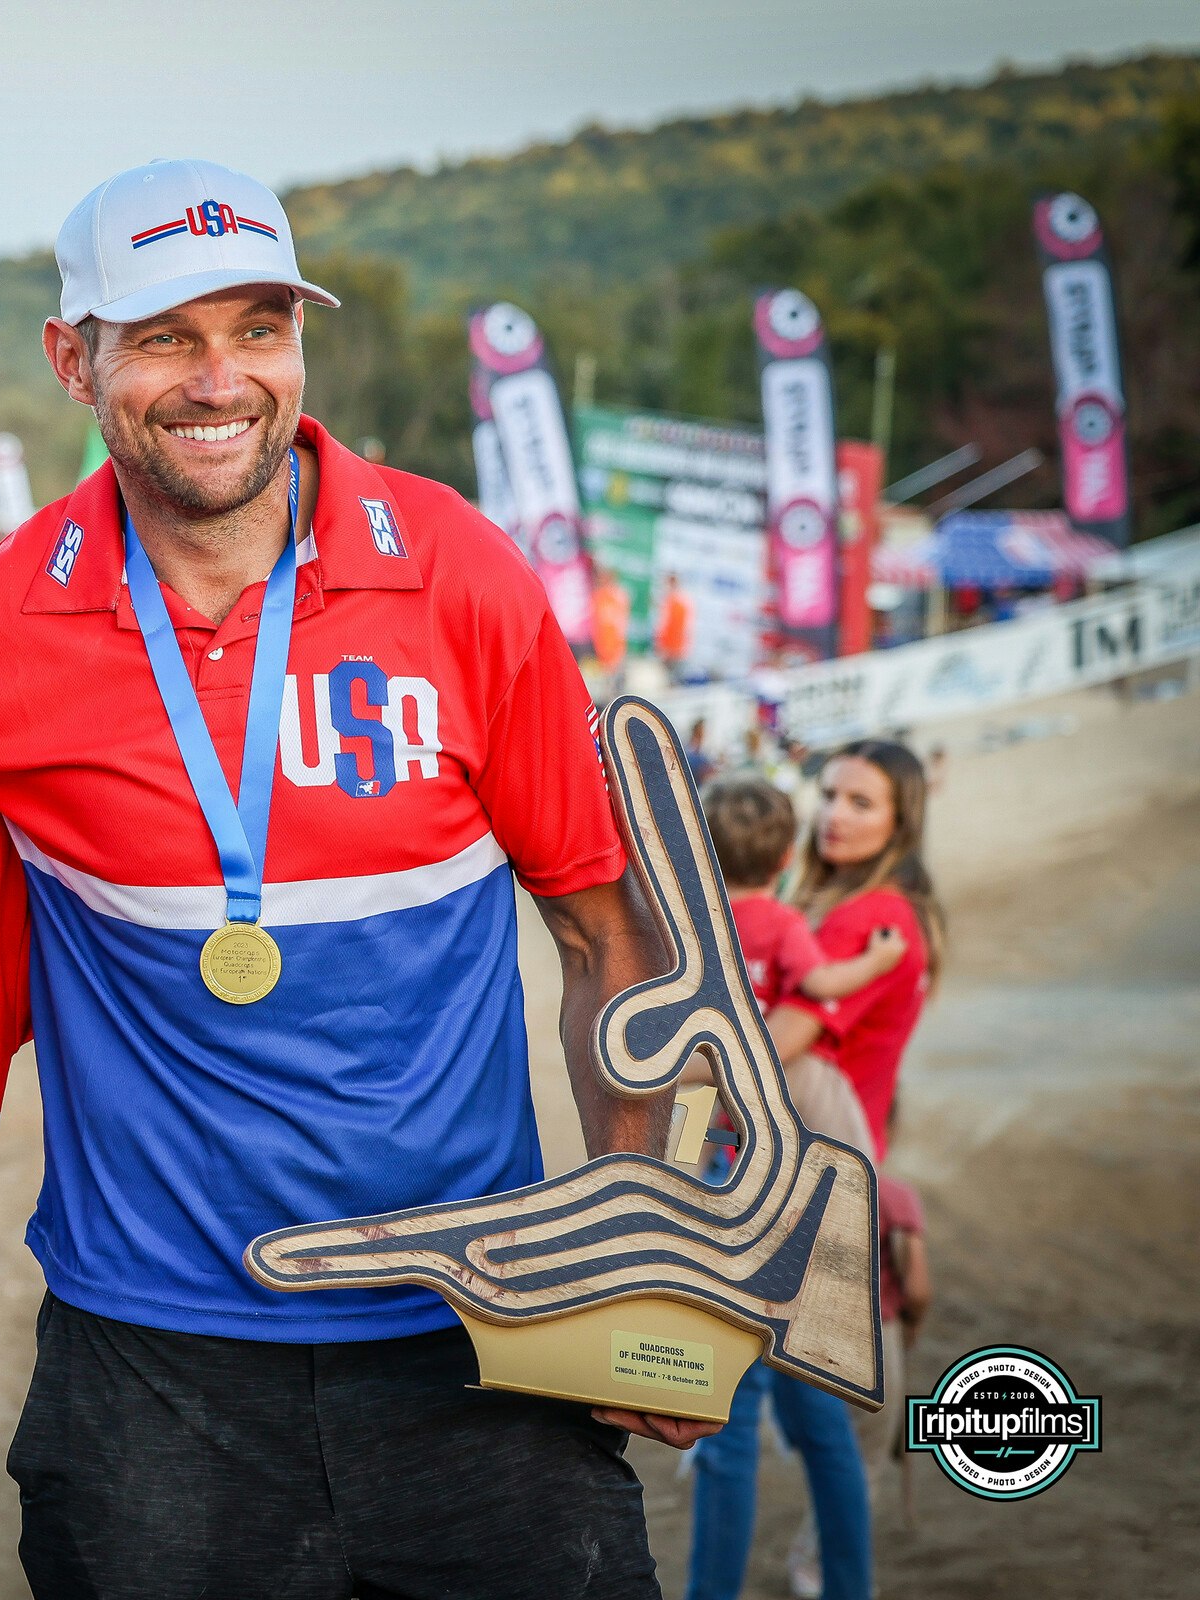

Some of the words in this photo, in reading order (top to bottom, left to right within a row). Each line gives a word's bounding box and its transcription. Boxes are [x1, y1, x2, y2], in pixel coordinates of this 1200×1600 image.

[186, 199, 238, 237] USA
[341, 654, 373, 662] TEAM
[279, 661, 443, 798] USA
[674, 1085, 718, 1165] 1
[640, 1342, 684, 1357] QUADCROSS
[619, 1350, 629, 1359] OF
[631, 1352, 671, 1366] EUROPEAN
[673, 1357, 705, 1371] NATIONS
[615, 1366, 637, 1376] CINGOLI
[642, 1371, 657, 1379] ITALY
[662, 1373, 671, 1381] 7-8
[672, 1375, 694, 1385] October
[695, 1379, 709, 1387] 2023
